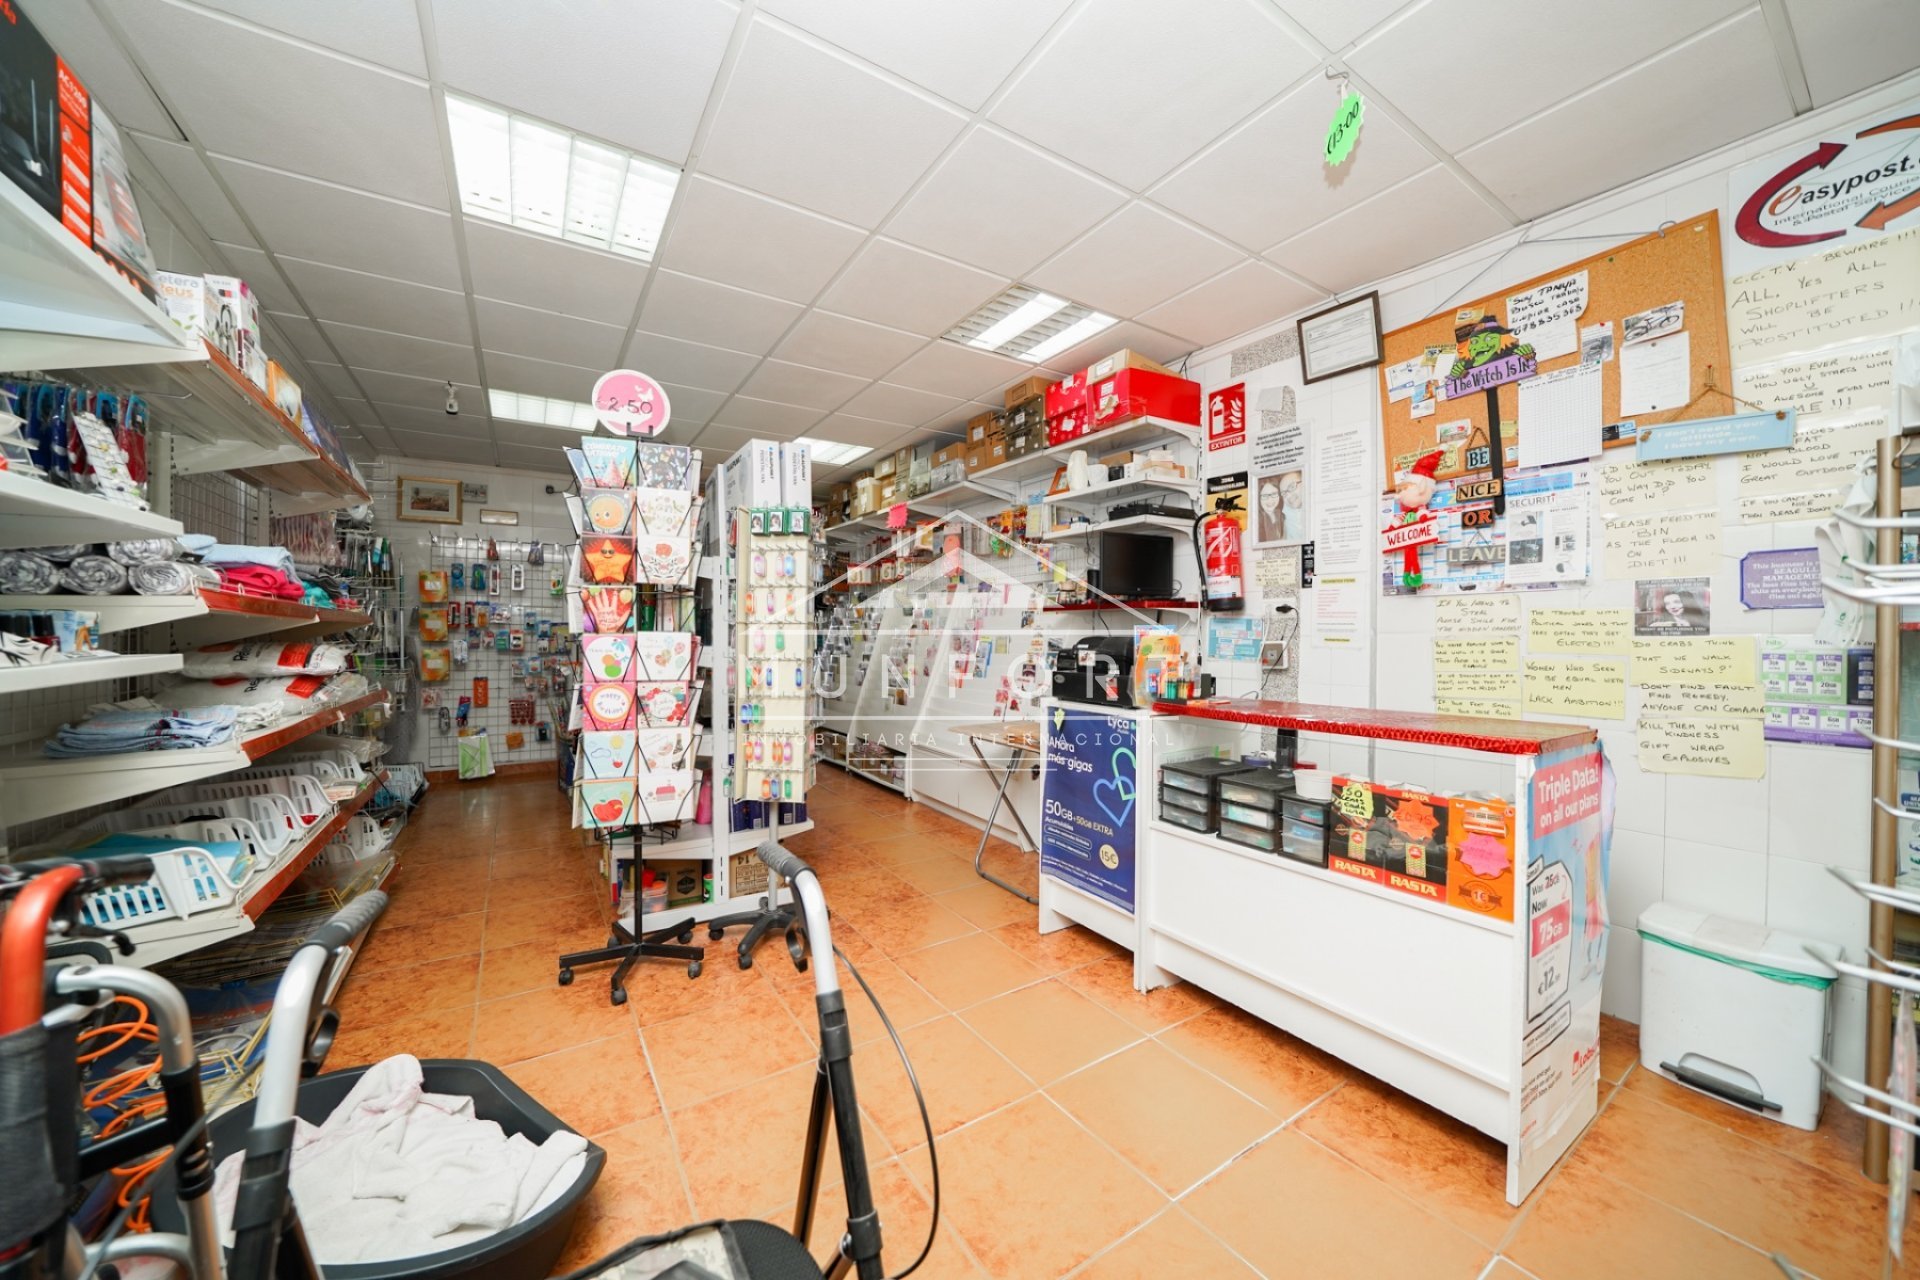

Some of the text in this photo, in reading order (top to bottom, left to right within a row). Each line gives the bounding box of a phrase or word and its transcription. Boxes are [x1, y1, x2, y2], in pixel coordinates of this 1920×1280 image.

[1768, 153, 1920, 216] easypost.
[1773, 191, 1864, 226] International
[1823, 238, 1889, 262] BEWARE
[1798, 276, 1823, 289] YES
[1847, 260, 1887, 274] ALL
[1746, 281, 1885, 321] SHOPLIFTERS
[1809, 359, 1838, 371] EVER
[1452, 378, 1473, 395] The
[1472, 367, 1503, 387] Witch
[1505, 361, 1517, 377] Is
[1774, 390, 1825, 403] AWESOME
[1698, 424, 1731, 434] need
[1734, 419, 1767, 430] your
[1211, 436, 1244, 450] EXTINTOR
[1670, 439, 1704, 450] have
[1706, 438, 1726, 447] my
[1469, 451, 1489, 467] BE
[1458, 481, 1499, 499] NICE
[1463, 510, 1492, 526] OR
[1605, 518, 1652, 531] PLEASE
[1387, 525, 1432, 546] WELCOME
[1449, 548, 1505, 563] LEAVE
[1525, 662, 1556, 672] WOMEN
[1642, 703, 1718, 712] ANYONE CAN
[1107, 715, 1130, 730] Lyca
[1639, 721, 1740, 732] KILL THEM WITH
[1664, 731, 1720, 739] KINDNESS
[1048, 736, 1075, 752] Ahora
[1691, 744, 1725, 752] WRAP
[1048, 753, 1093, 773] más gigas
[1538, 763, 1599, 804] Triple Data!
[1401, 792, 1430, 802] RASTA
[1045, 799, 1073, 821] 50GB
[1093, 821, 1114, 837] EXTRA
[1540, 792, 1599, 828] on all our plans
[1335, 859, 1377, 879] RASTA
[1390, 874, 1438, 897] RASTA
[1531, 898, 1547, 915] Now
